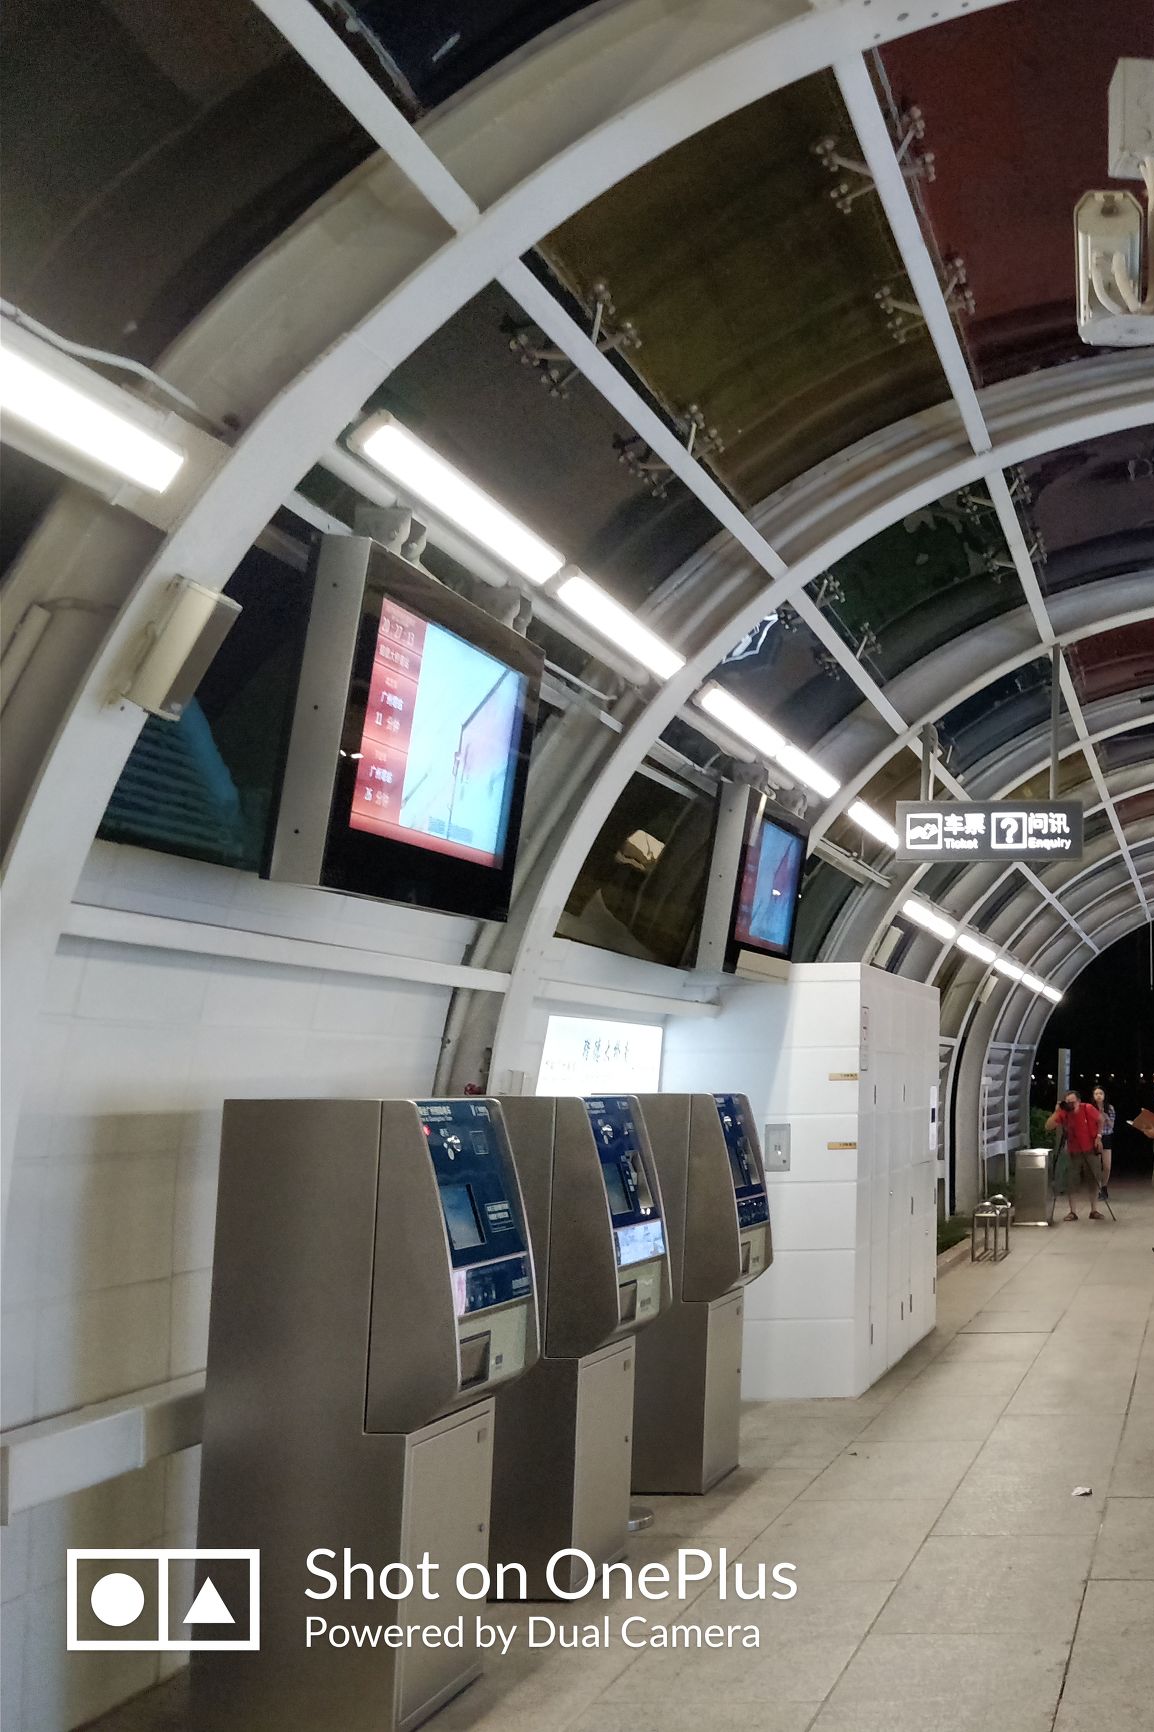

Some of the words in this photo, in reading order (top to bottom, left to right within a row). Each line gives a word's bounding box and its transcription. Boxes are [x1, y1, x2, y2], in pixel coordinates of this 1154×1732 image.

[944, 813, 986, 835] 车票
[1028, 812, 1070, 835] 问讯
[944, 838, 979, 849] Ticket
[1028, 837, 1072, 850] Enquiry
